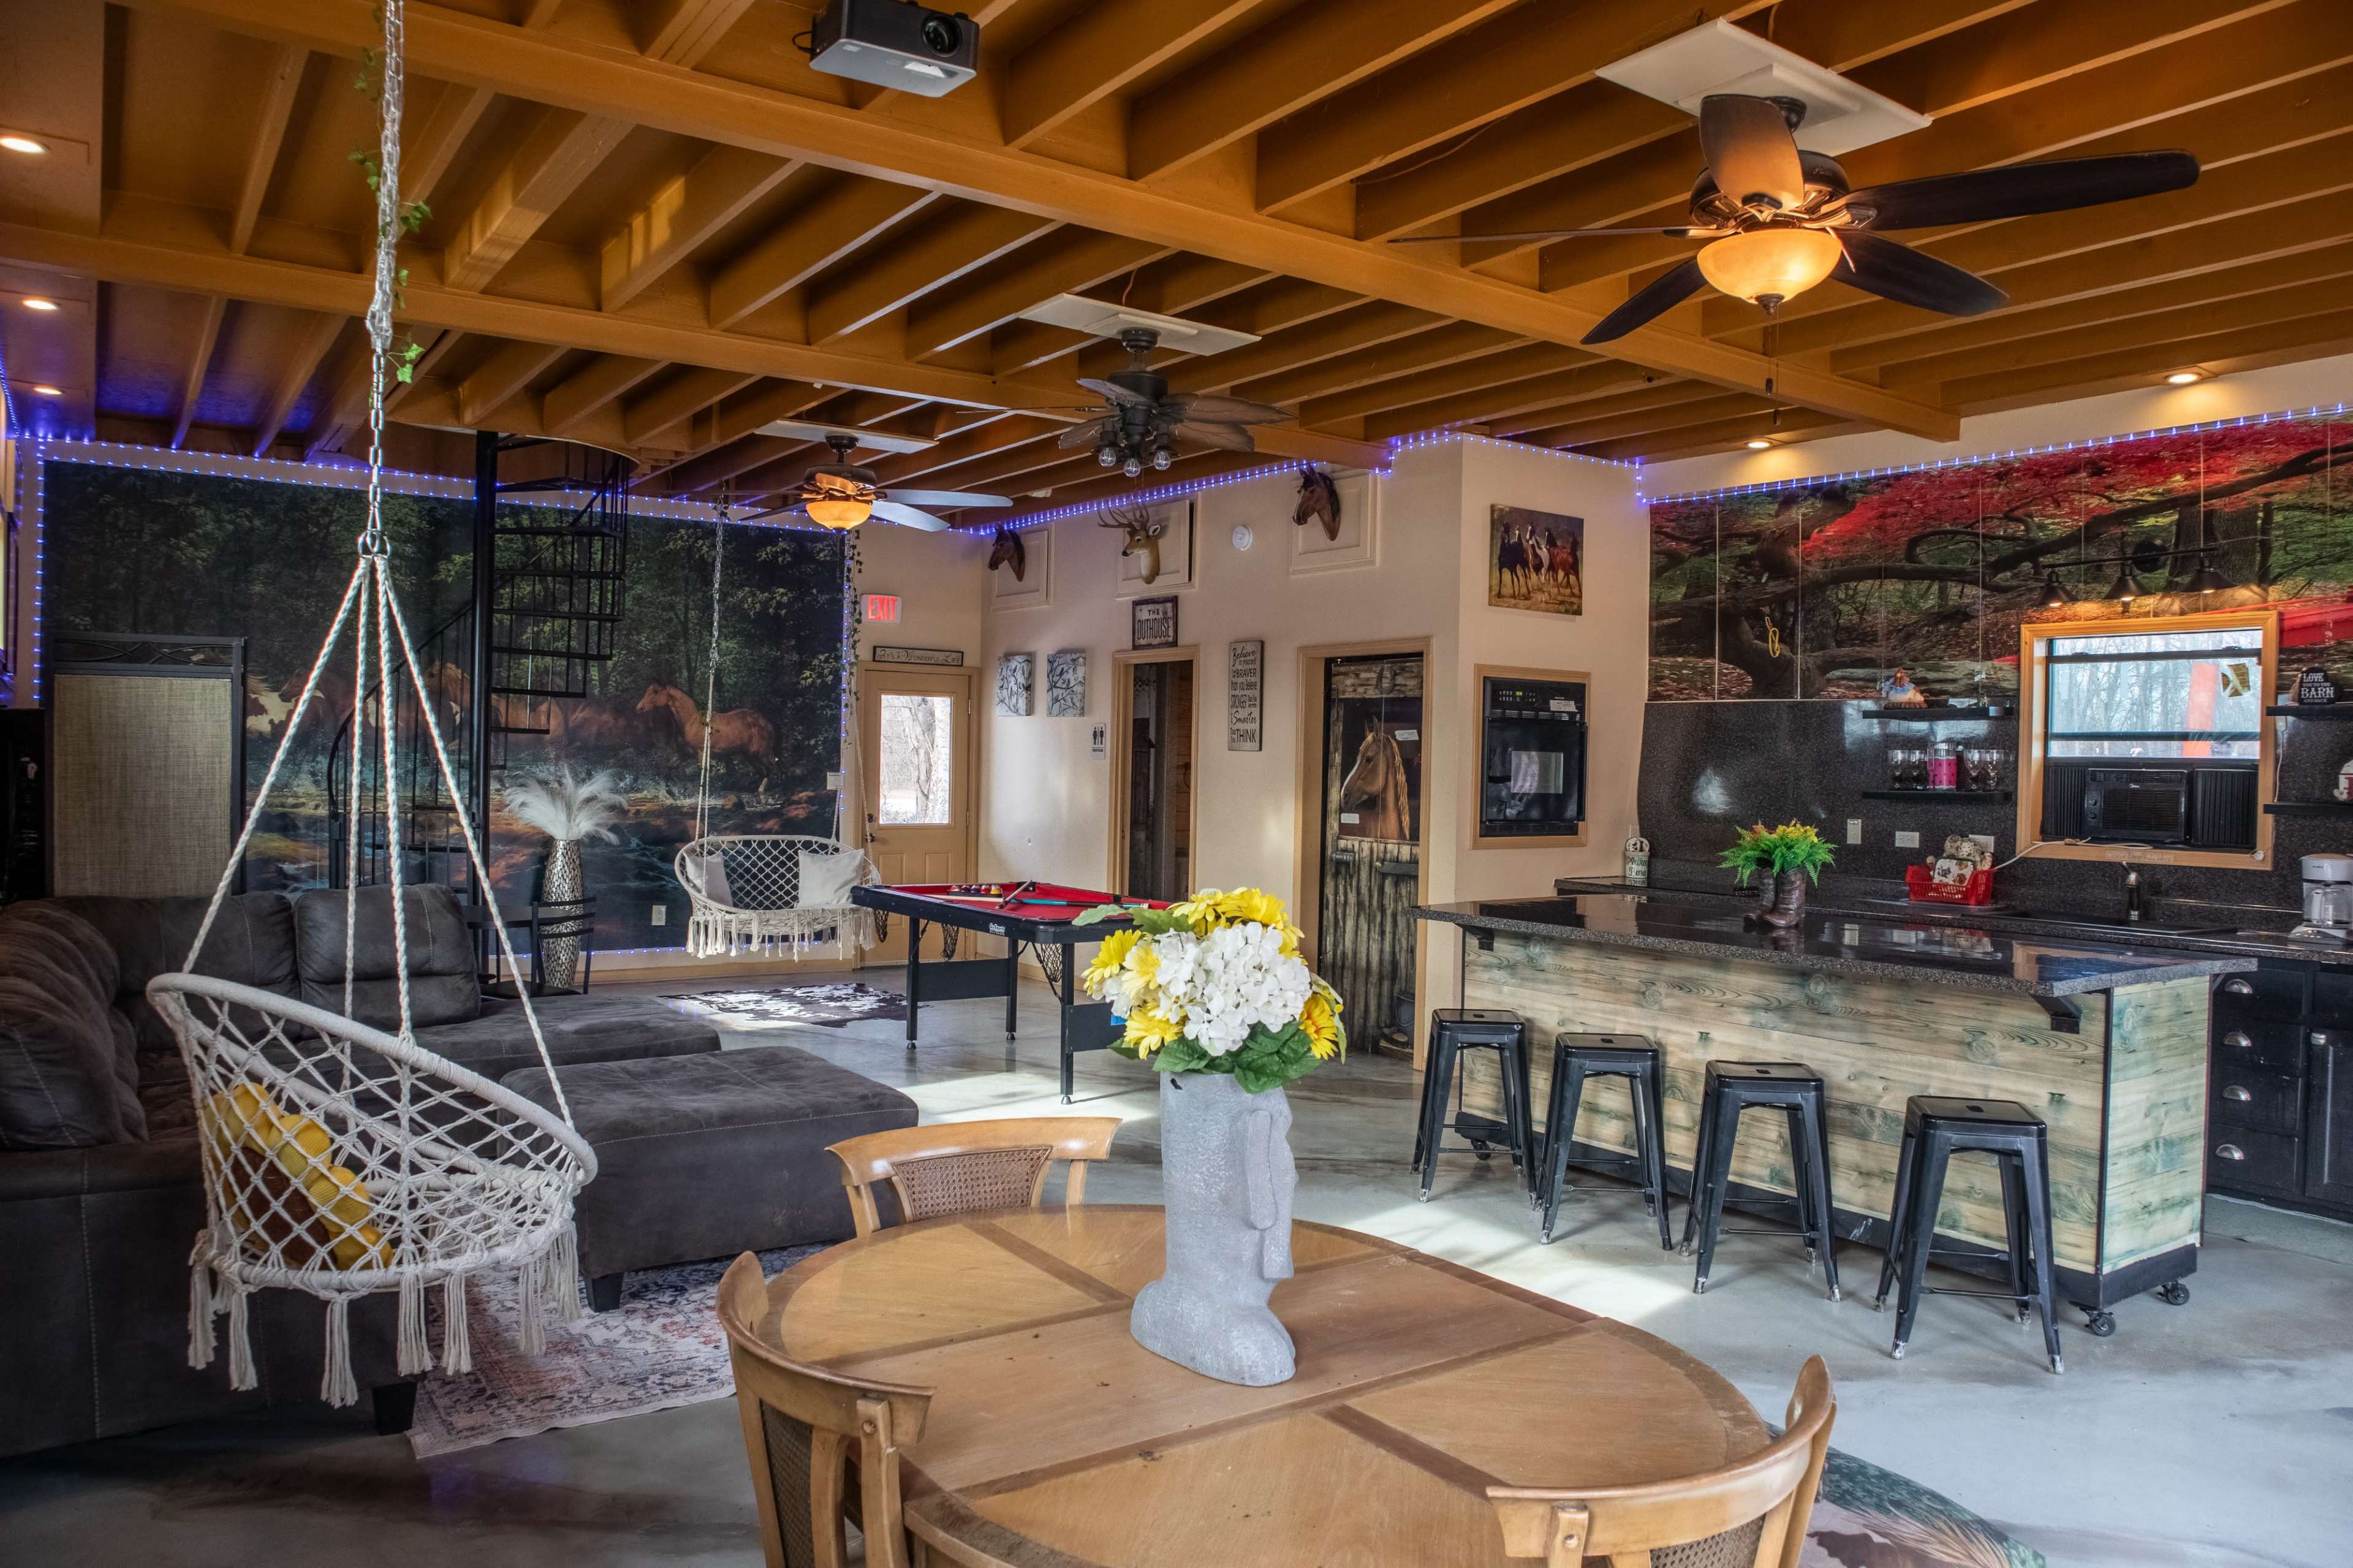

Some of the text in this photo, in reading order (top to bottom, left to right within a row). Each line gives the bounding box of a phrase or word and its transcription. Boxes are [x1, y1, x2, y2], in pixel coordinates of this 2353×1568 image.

[867, 596, 898, 620] EXIT
[1147, 608, 1160, 616] THE
[1137, 616, 1172, 640] OUTHOUSE
[1232, 645, 1256, 667] Believe
[1237, 668, 1256, 678] BRAVER
[2303, 673, 2324, 682] LOVE
[2301, 687, 2334, 699] BARN
[1231, 694, 1247, 709] STRONGER
[1233, 710, 1257, 725] Smarter
[1236, 729, 1257, 743] THINK
